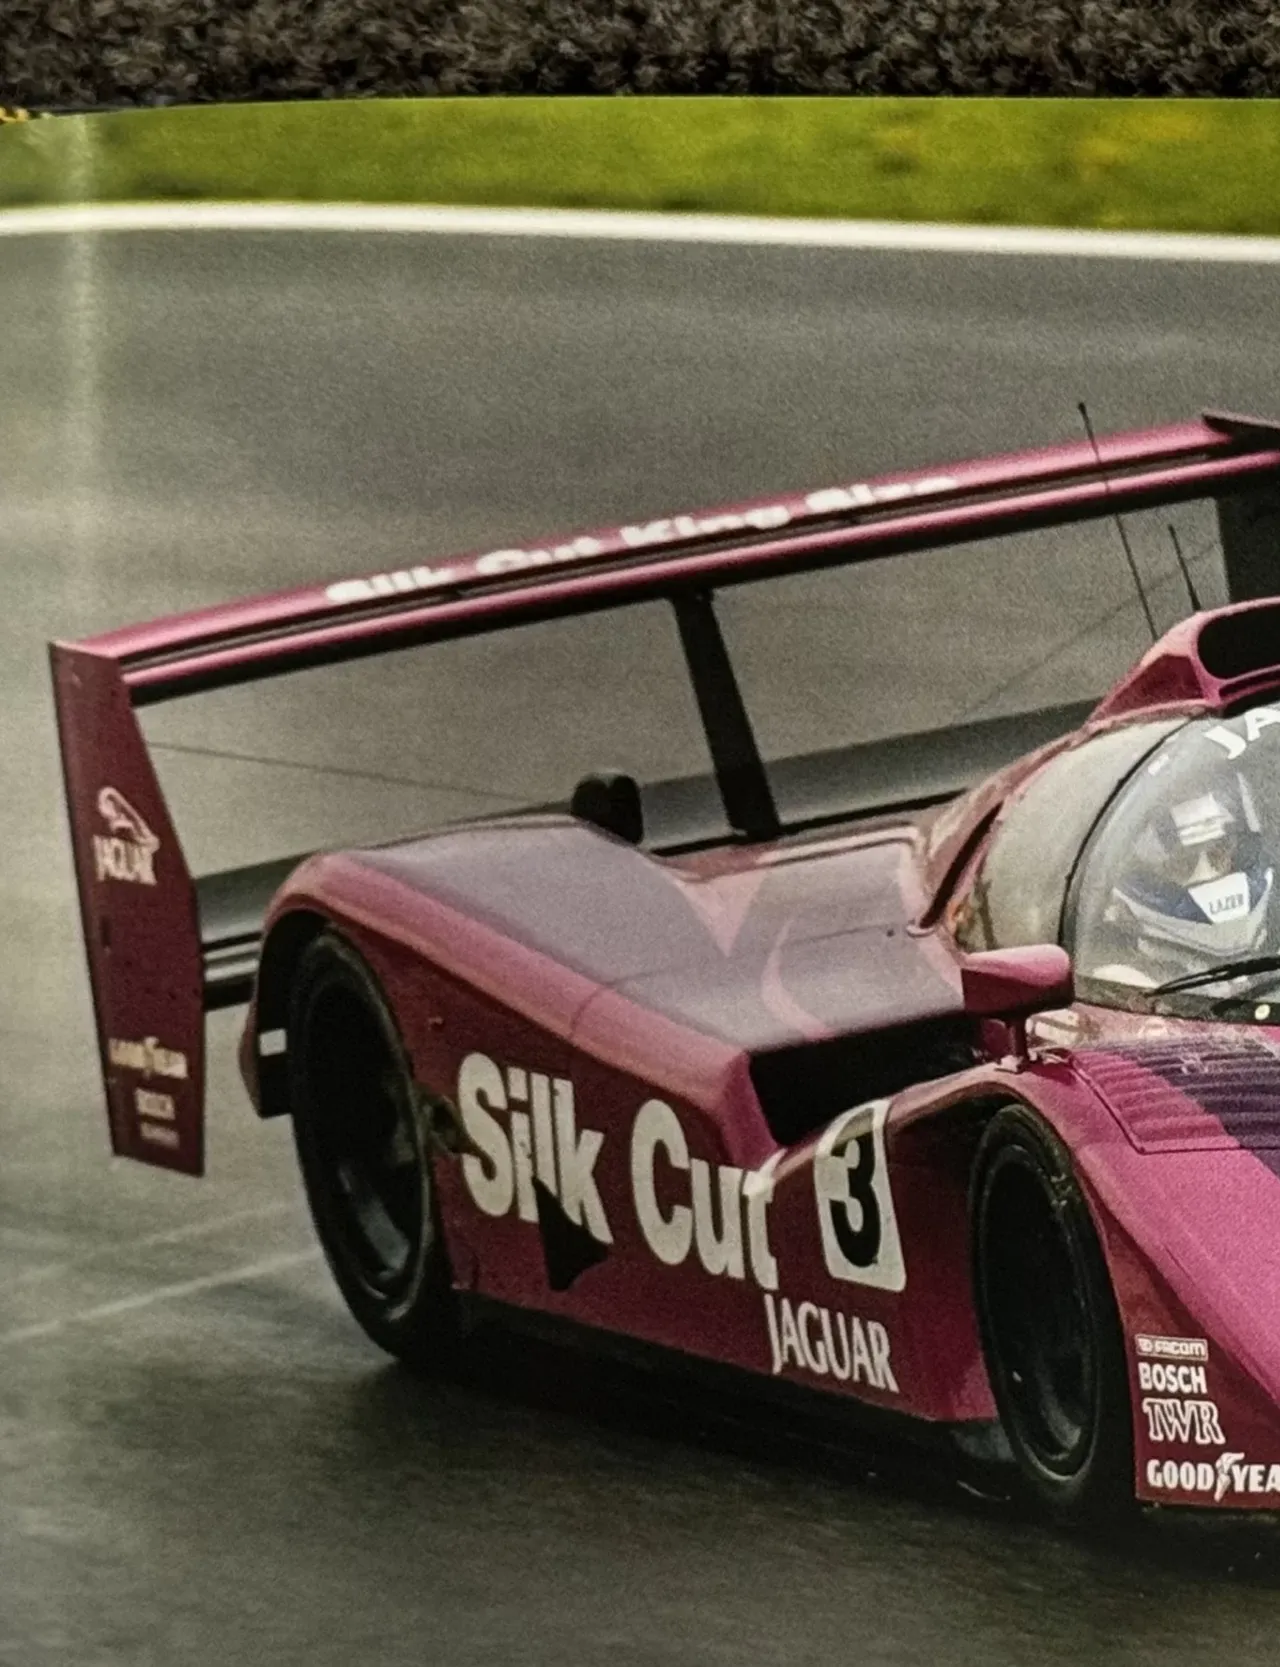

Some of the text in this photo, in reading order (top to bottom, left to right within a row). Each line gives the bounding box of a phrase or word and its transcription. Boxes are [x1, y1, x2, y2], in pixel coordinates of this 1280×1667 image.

[458, 1052, 786, 1290] Silk Cut
[830, 1106, 882, 1268] 3
[765, 1294, 899, 1393] JAGUAR
[1138, 1361, 1208, 1394] BOSCH
[1142, 1397, 1226, 1445] TWR
